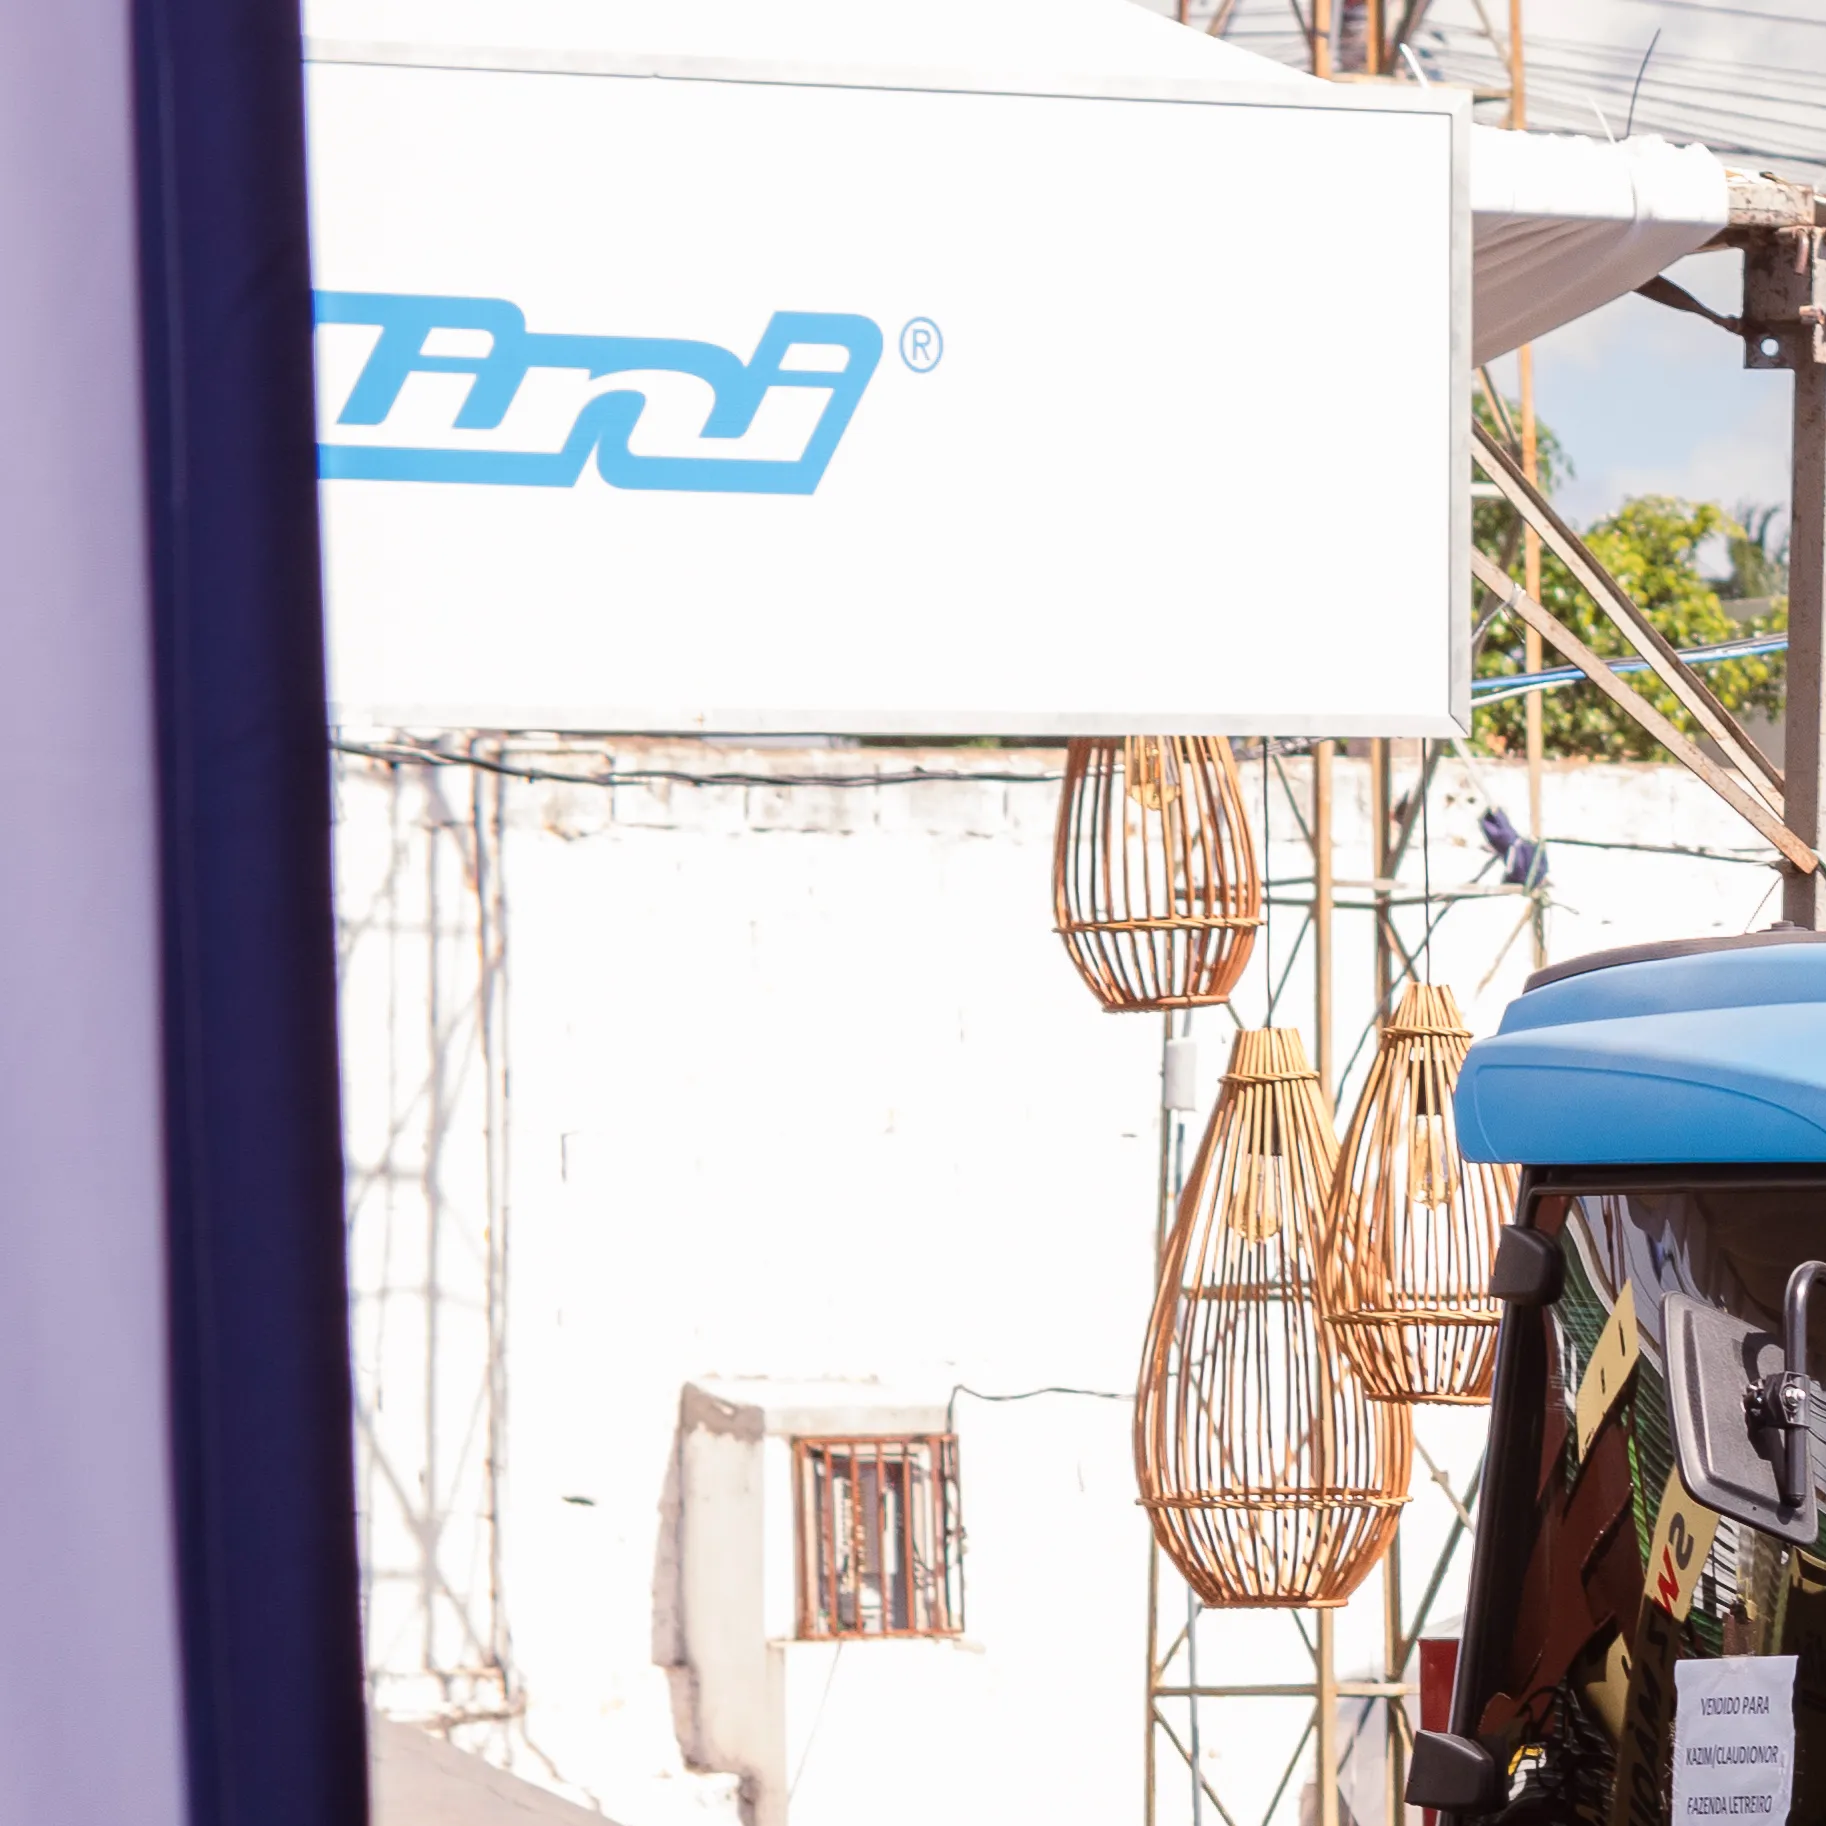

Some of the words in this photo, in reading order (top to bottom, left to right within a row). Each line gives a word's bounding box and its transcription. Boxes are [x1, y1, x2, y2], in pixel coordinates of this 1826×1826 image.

[1701, 1696, 1740, 1716] VENDIDO
[1742, 1696, 1770, 1714] PARA
[1685, 1744, 1779, 1769] KAZIM/CLAUDIONOR
[1687, 1796, 1728, 1815] FAZENDA
[1729, 1795, 1772, 1815] LETREIRO
